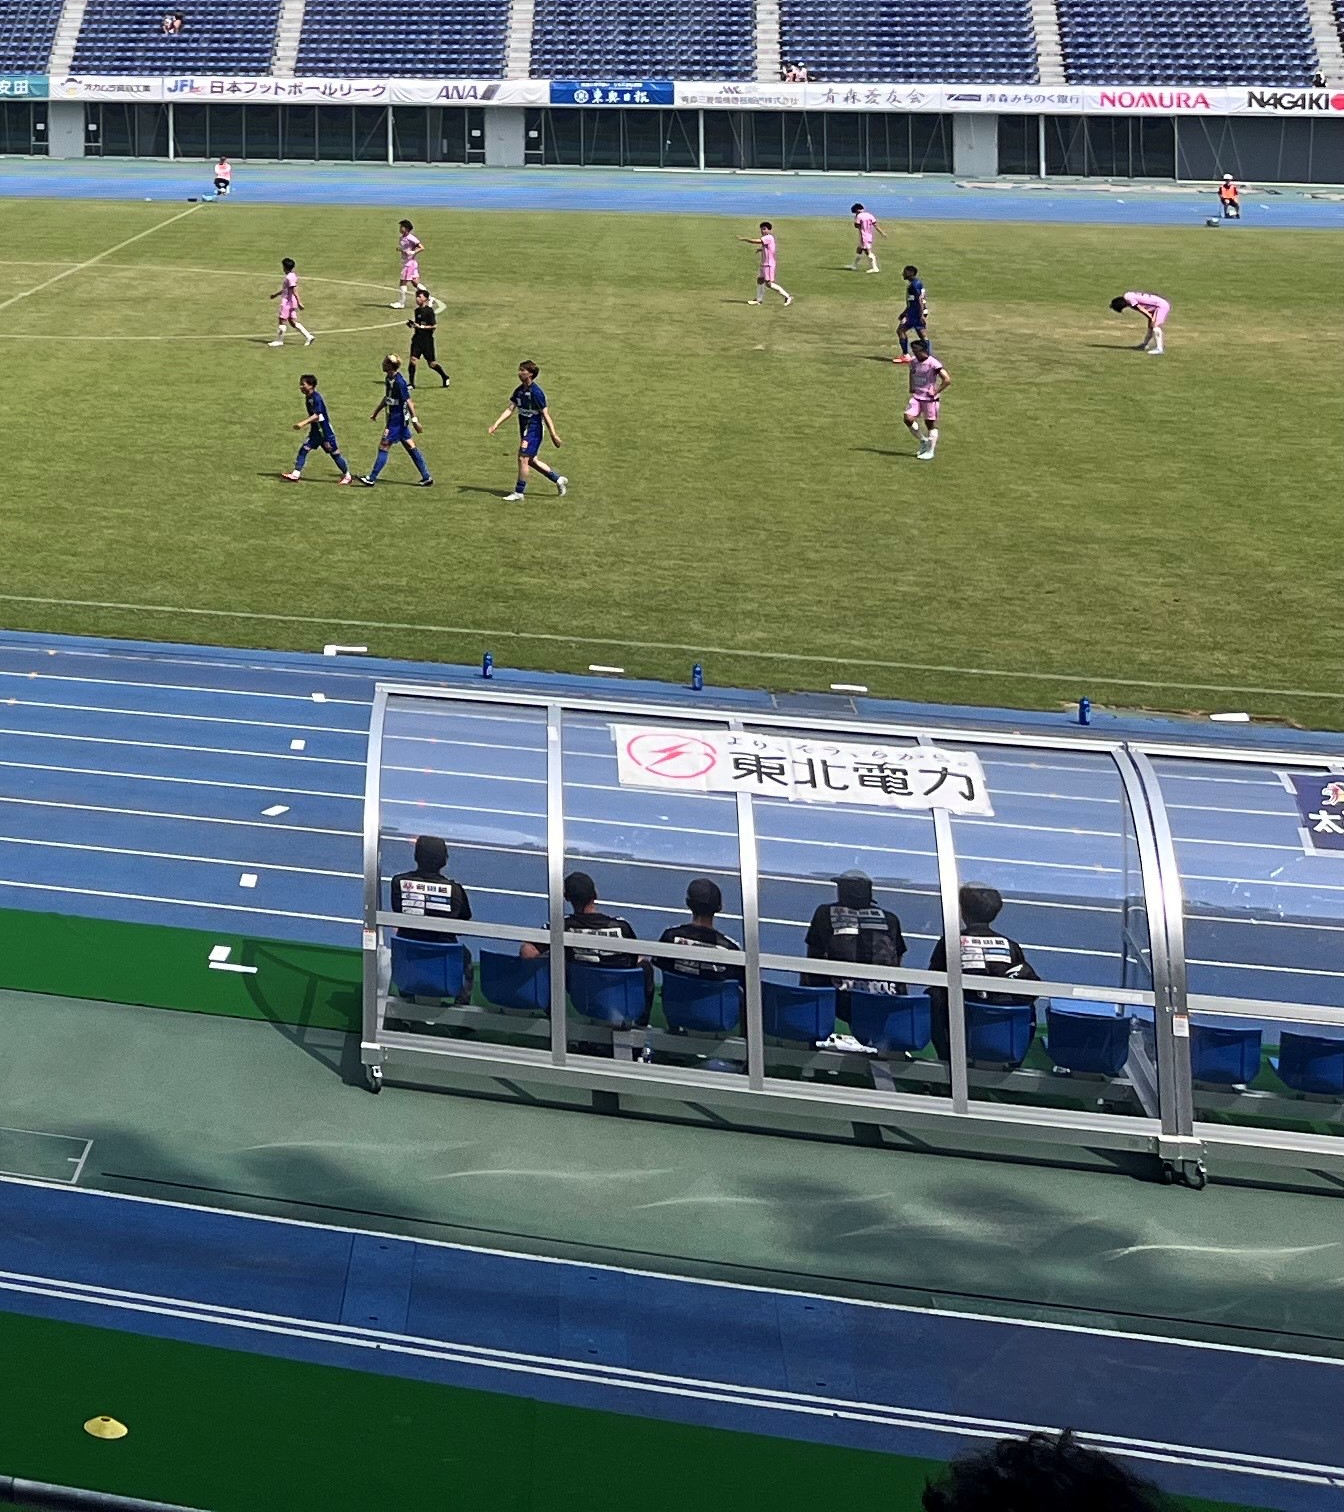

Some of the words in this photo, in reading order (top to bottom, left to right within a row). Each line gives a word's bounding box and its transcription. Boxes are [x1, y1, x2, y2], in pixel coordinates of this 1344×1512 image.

[167, 79, 196, 93] JFL
[210, 80, 386, 98] 日本フットボールリーグ
[437, 85, 479, 100] ANA
[1100, 92, 1211, 109] NOMURA
[1247, 91, 1329, 110] NAGAKI
[729, 750, 976, 802] 東北電力
